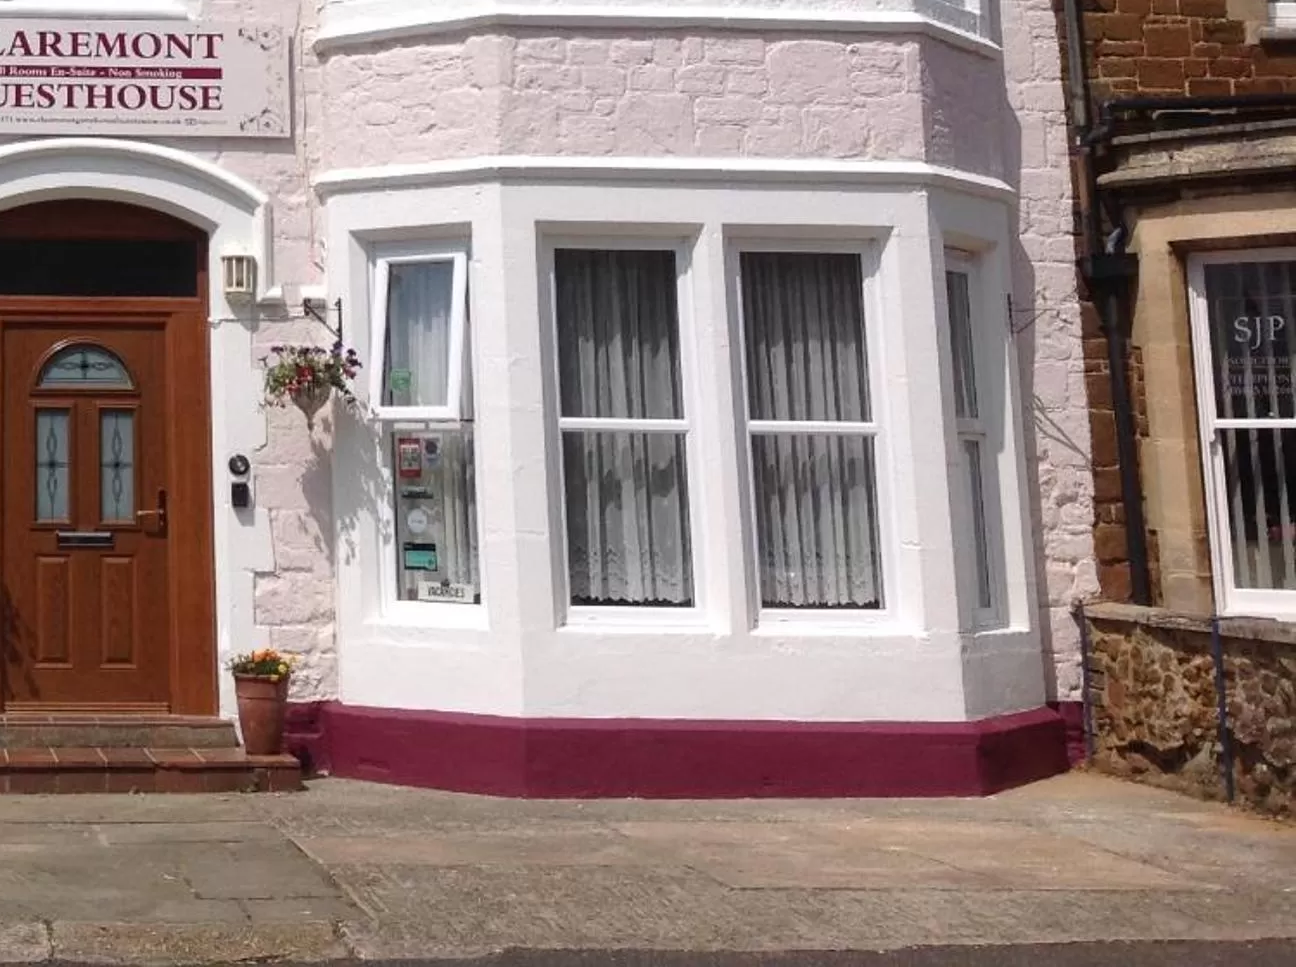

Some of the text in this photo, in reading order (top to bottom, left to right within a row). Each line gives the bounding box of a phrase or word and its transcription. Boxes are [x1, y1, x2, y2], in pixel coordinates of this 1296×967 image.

[9, 66, 47, 76] Rooms
[51, 66, 96, 77] En-Suite
[108, 68, 132, 78] Non
[136, 68, 183, 79] Smoking
[1233, 315, 1285, 350] SJP
